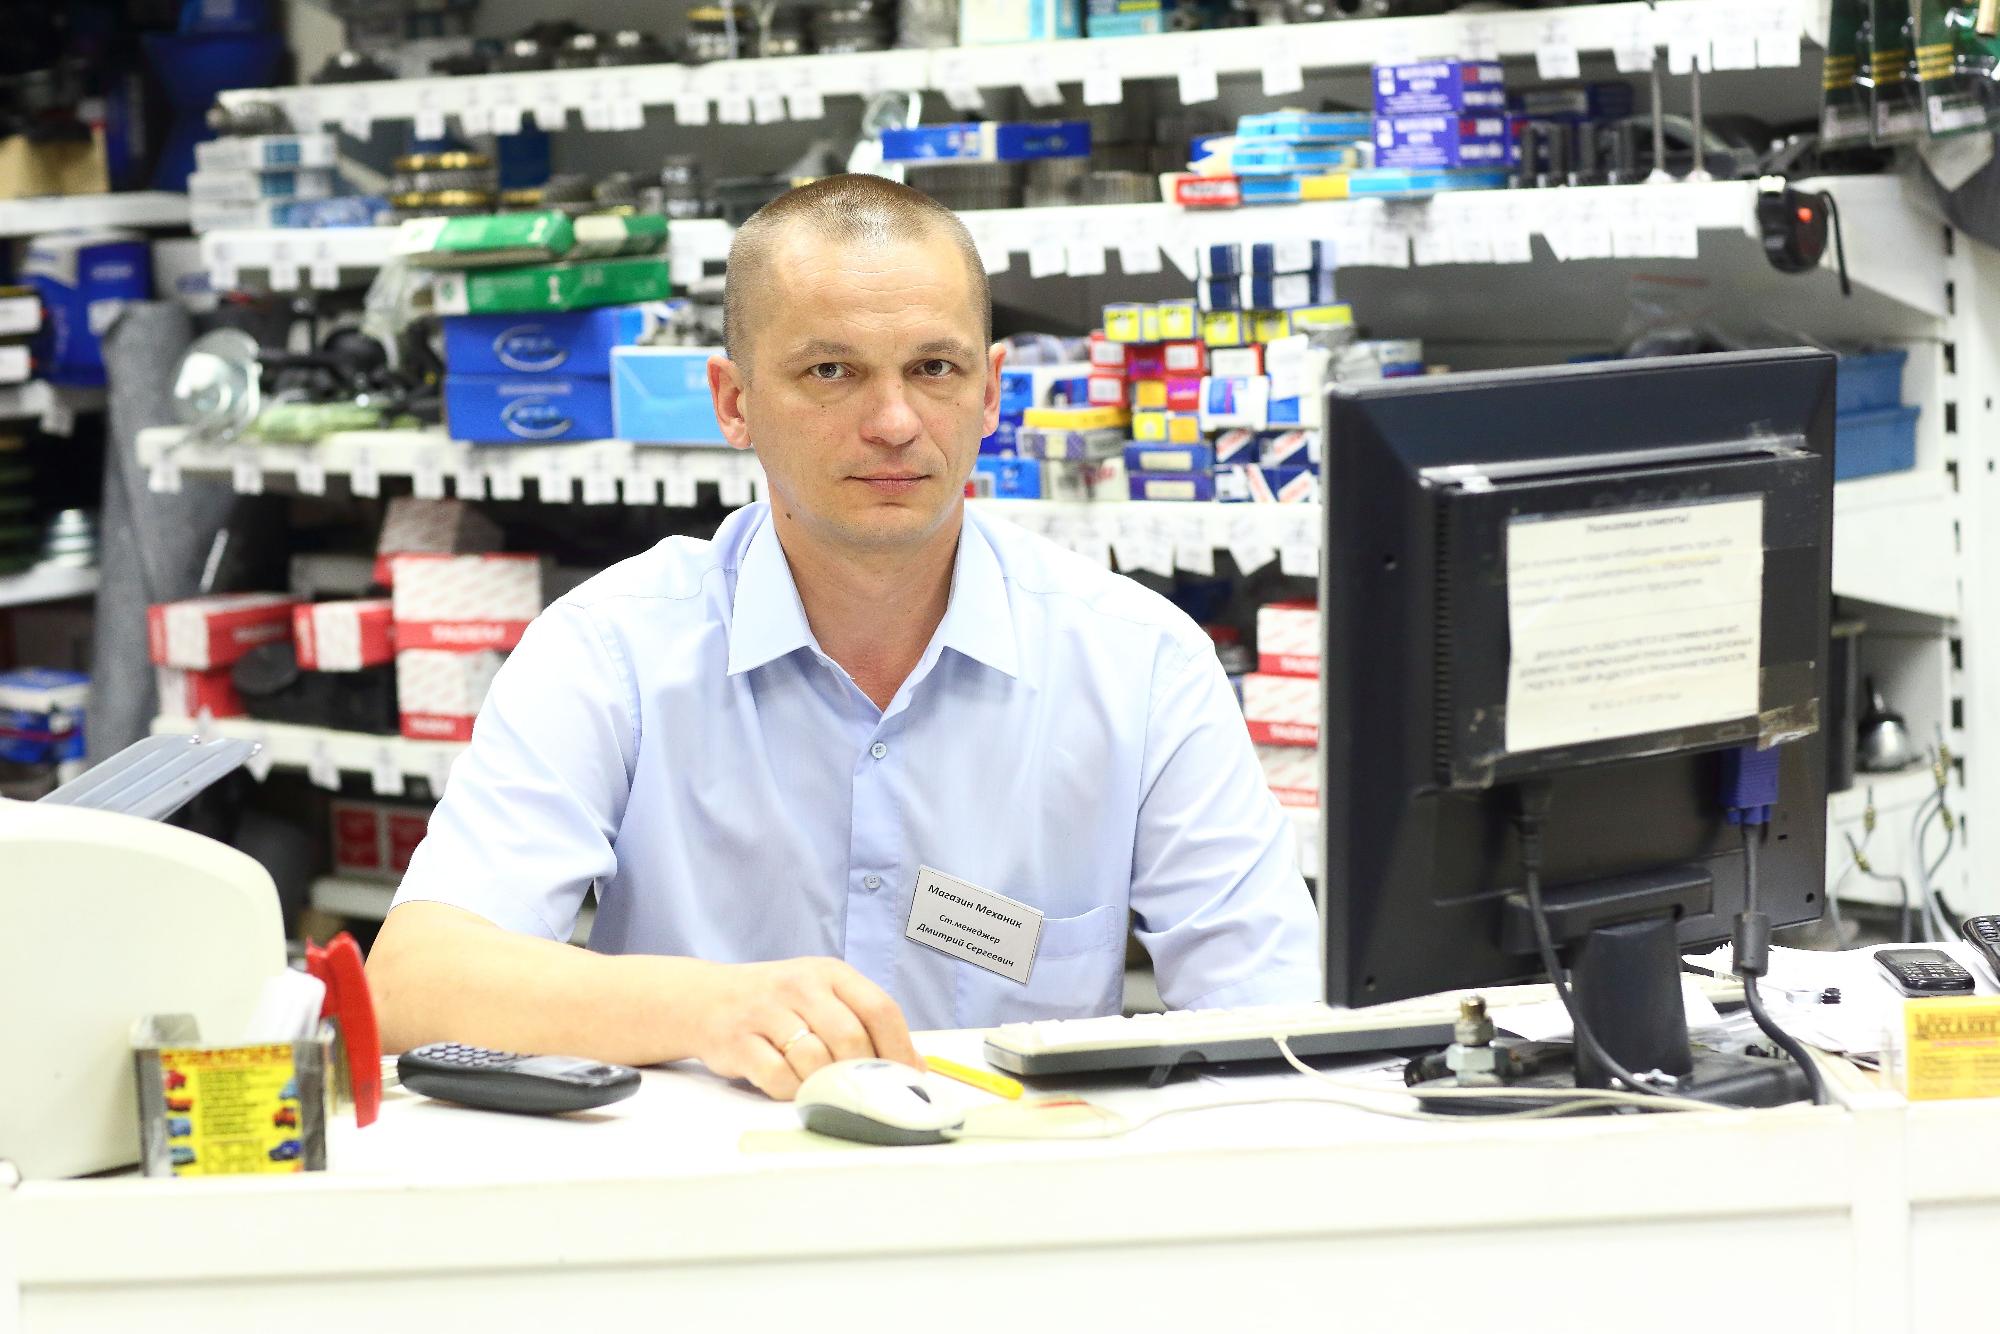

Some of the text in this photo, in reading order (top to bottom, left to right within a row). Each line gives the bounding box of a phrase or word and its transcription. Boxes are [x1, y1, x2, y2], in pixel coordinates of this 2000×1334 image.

[928, 884, 1022, 929] Магазин Механик
[917, 923, 1014, 967] Дмитрий Сергеевич
[939, 914, 1001, 945] Ст.менеджер
